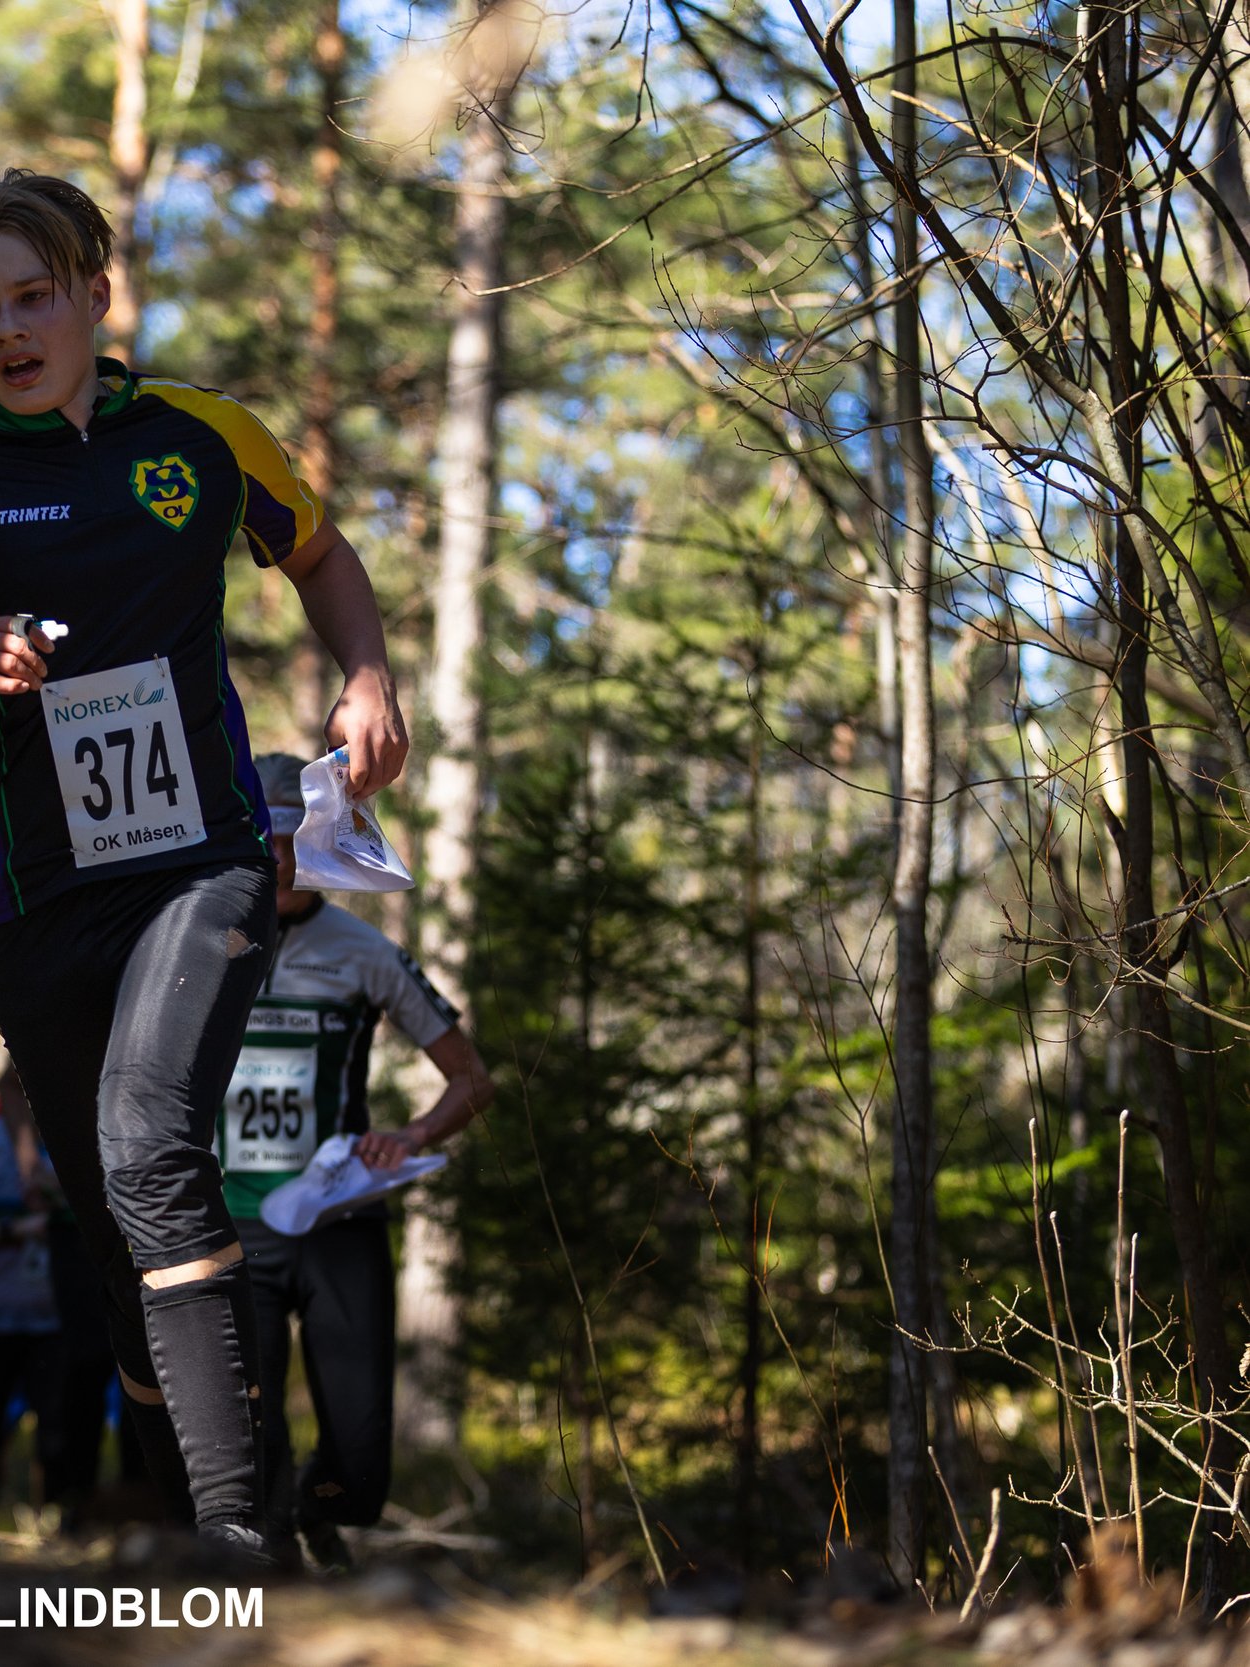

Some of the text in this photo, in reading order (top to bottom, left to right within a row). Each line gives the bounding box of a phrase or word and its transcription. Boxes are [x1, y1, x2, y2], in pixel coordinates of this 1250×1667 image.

[163, 505, 188, 519] OL
[53, 692, 133, 724] NOREX
[74, 720, 179, 822] 374
[92, 822, 185, 853] OK Måsen
[238, 1085, 303, 1141] 255
